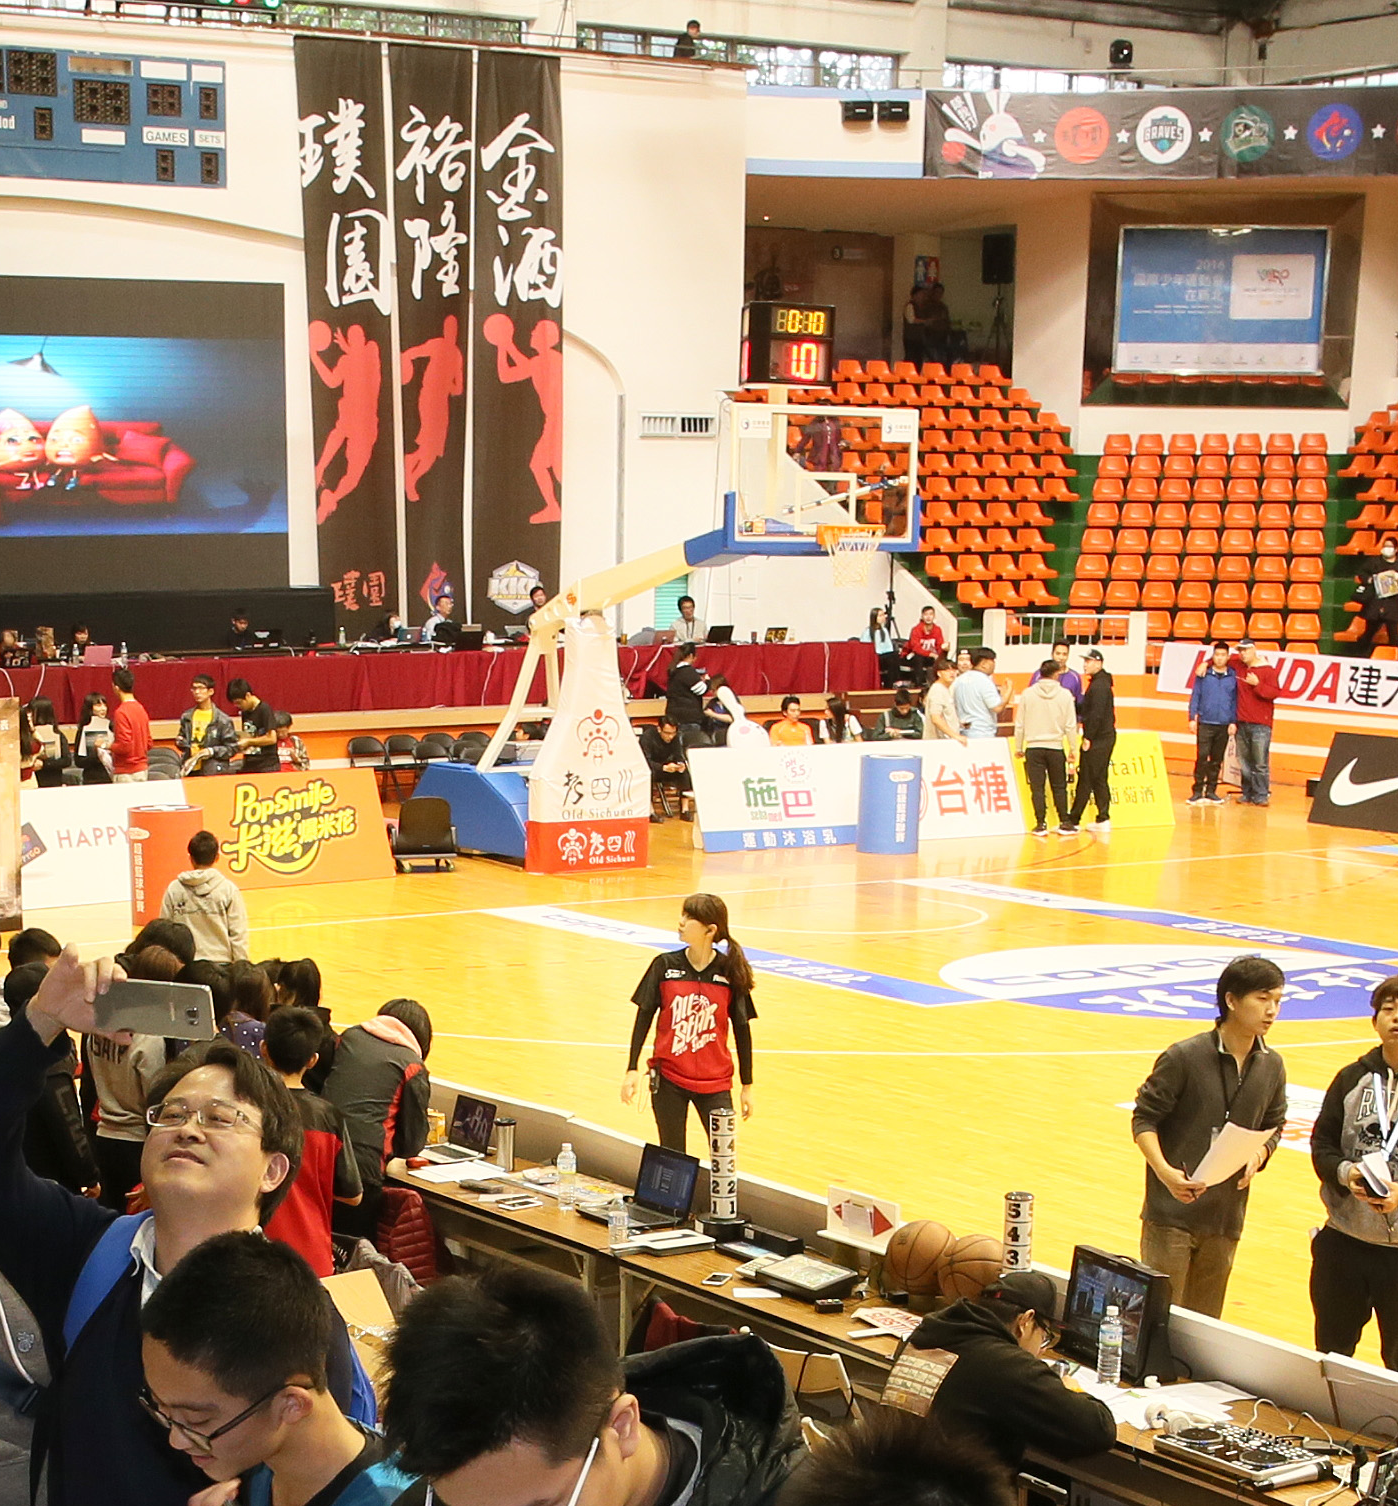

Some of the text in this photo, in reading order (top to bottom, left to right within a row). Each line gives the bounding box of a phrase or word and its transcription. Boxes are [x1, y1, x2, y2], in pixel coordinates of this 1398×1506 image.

[145, 131, 187, 144] GAMES
[199, 134, 221, 145] SETS
[1143, 125, 1184, 142] BRAVES
[298, 98, 392, 316] 璞園
[396, 105, 472, 301] 裕隆
[481, 113, 564, 309] 金酒
[743, 777, 815, 818] 施巴
[931, 763, 1012, 817] 台糖
[562, 807, 633, 820] Old Sichuan
[742, 829, 837, 848] 運動沐浴乳
[589, 856, 604, 865] Old
[1008, 1203, 1021, 1218] 5
[1007, 1226, 1019, 1242] 4
[1006, 1250, 1019, 1265] 3
